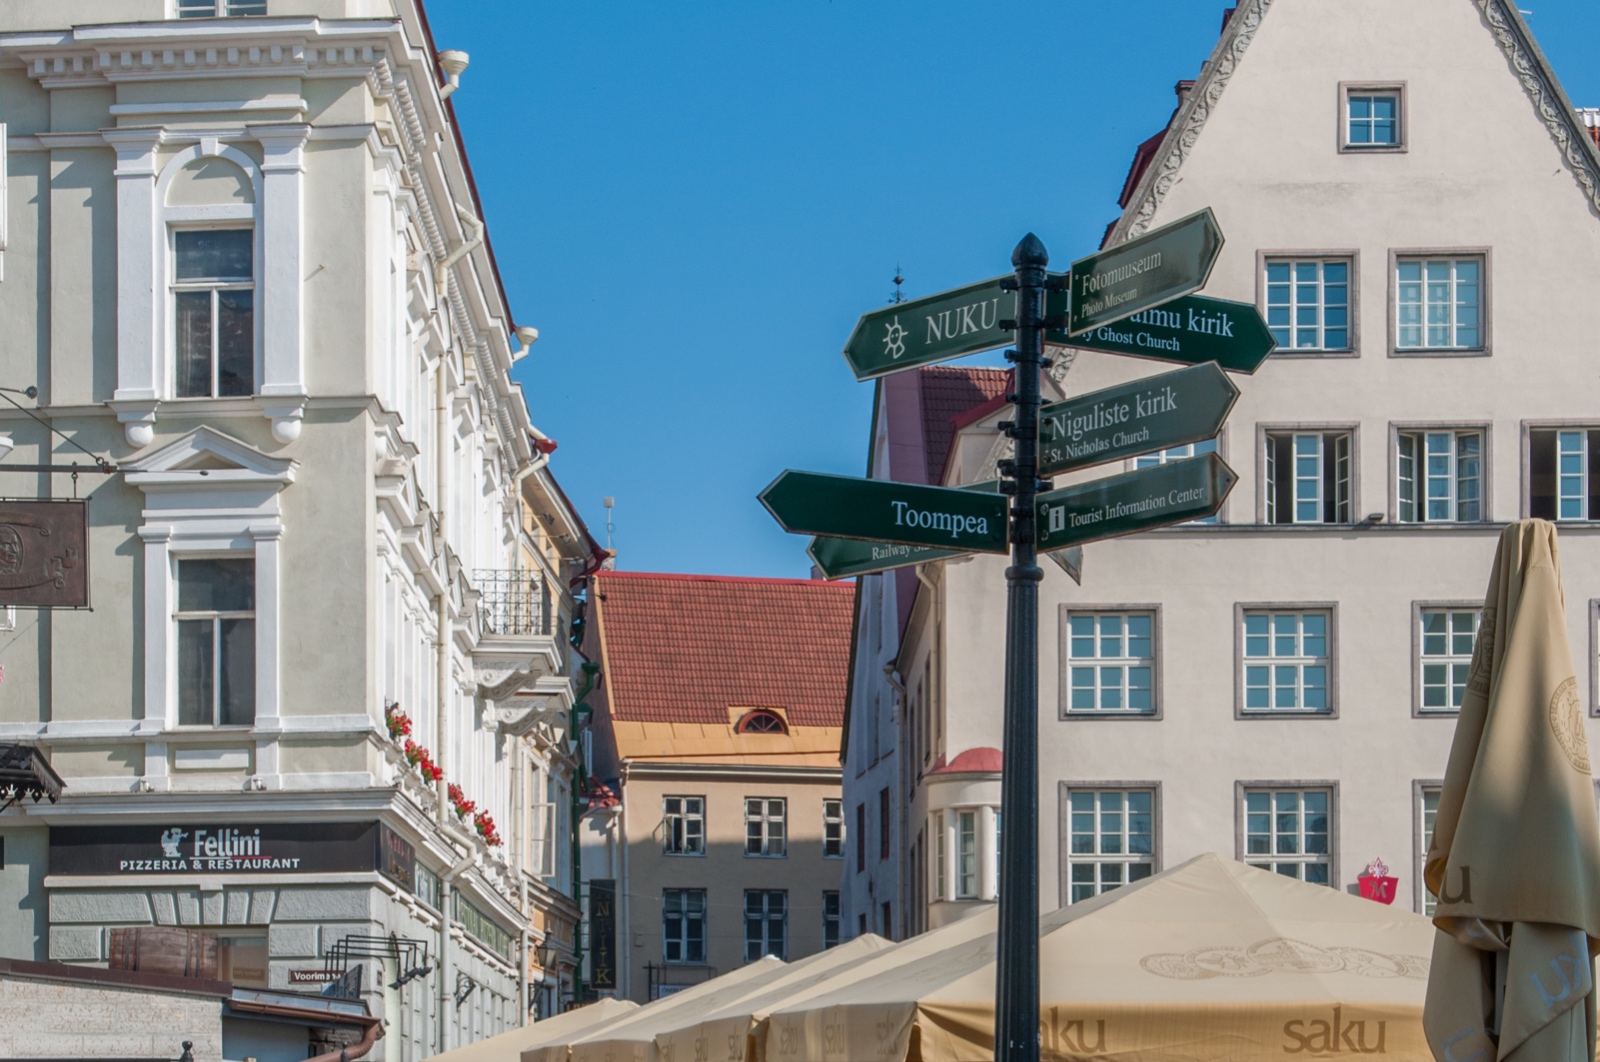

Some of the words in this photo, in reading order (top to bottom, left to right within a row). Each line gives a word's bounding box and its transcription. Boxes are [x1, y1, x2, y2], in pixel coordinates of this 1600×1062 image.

[1081, 252, 1162, 296] Fotomuuseum
[925, 298, 999, 345] NUKU
[1081, 300, 1104, 319] Photo
[1104, 288, 1138, 309] Museum
[1097, 326, 1134, 345] Ghost
[1136, 332, 1181, 351] Church
[1187, 308, 1234, 338] kirik
[1051, 402, 1130, 441] Niguliste
[1135, 386, 1178, 419] kirik
[1051, 448, 1064, 463] St.
[1066, 438, 1110, 460] Nicholas
[1112, 426, 1150, 448] Church
[891, 501, 989, 538] Toompea
[1069, 508, 1103, 528] Tourist
[1105, 495, 1166, 520] Information
[1168, 487, 1205, 505] Center
[872, 543, 911, 561] Railway
[194, 828, 260, 857] Fellini
[120, 859, 187, 871] PIZZERIA
[193, 859, 203, 870] &
[208, 858, 300, 870] RESTAURANT
[1283, 1006, 1387, 1053] saku
